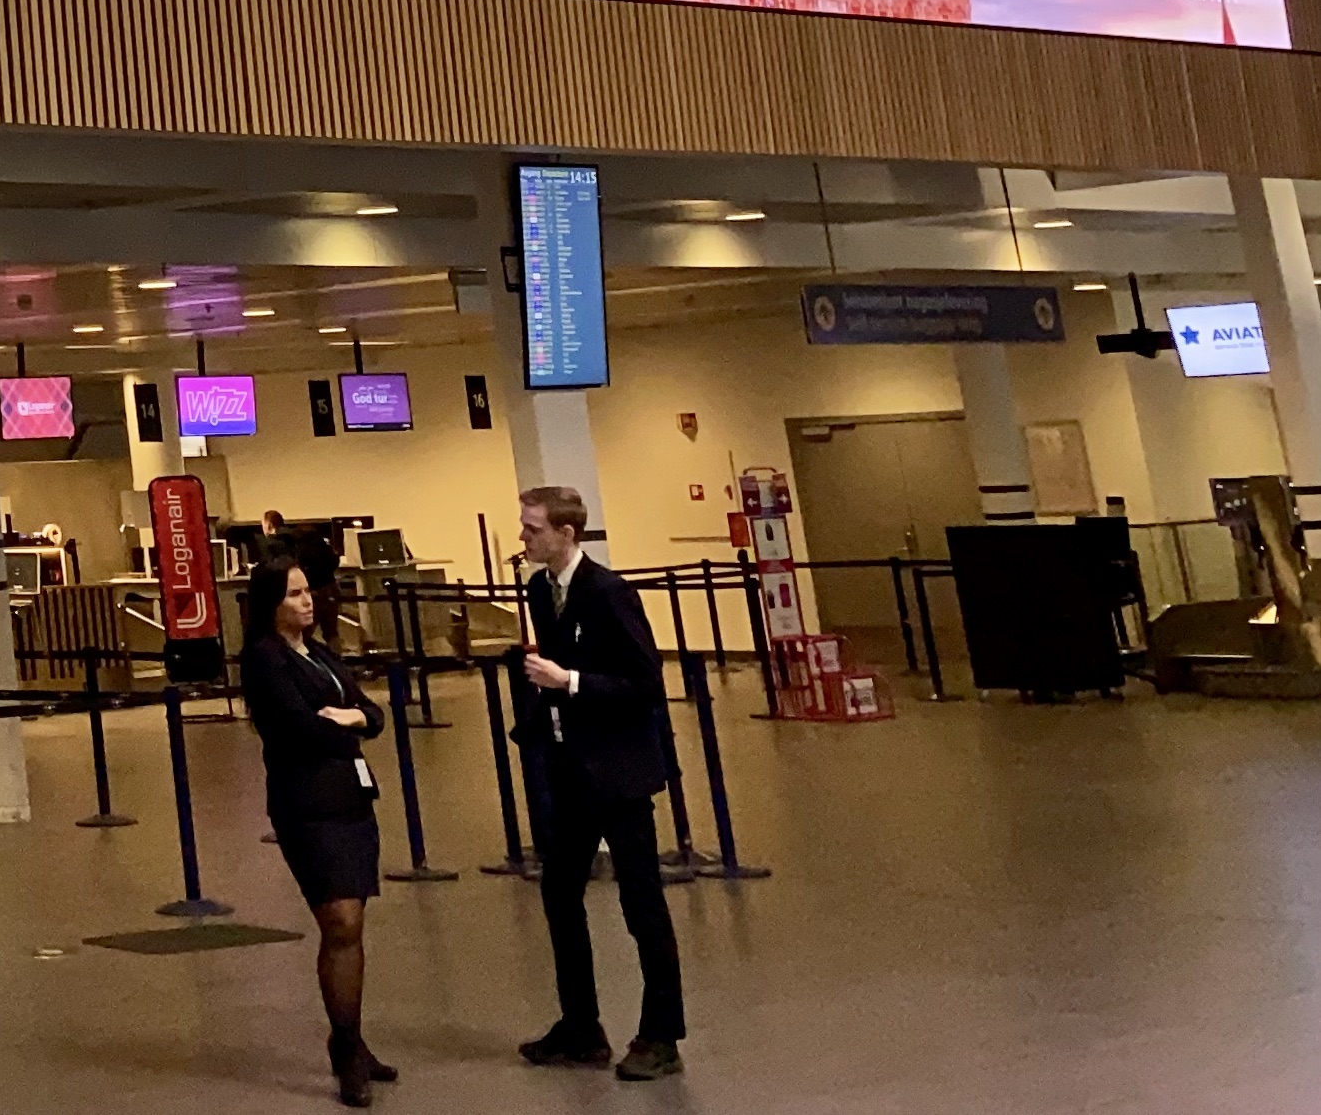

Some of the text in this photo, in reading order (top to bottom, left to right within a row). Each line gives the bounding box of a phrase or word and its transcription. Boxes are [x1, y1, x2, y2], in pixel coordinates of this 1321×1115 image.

[570, 171, 596, 184] 14:15
[473, 393, 485, 408] 16
[162, 488, 194, 590] Loganair
